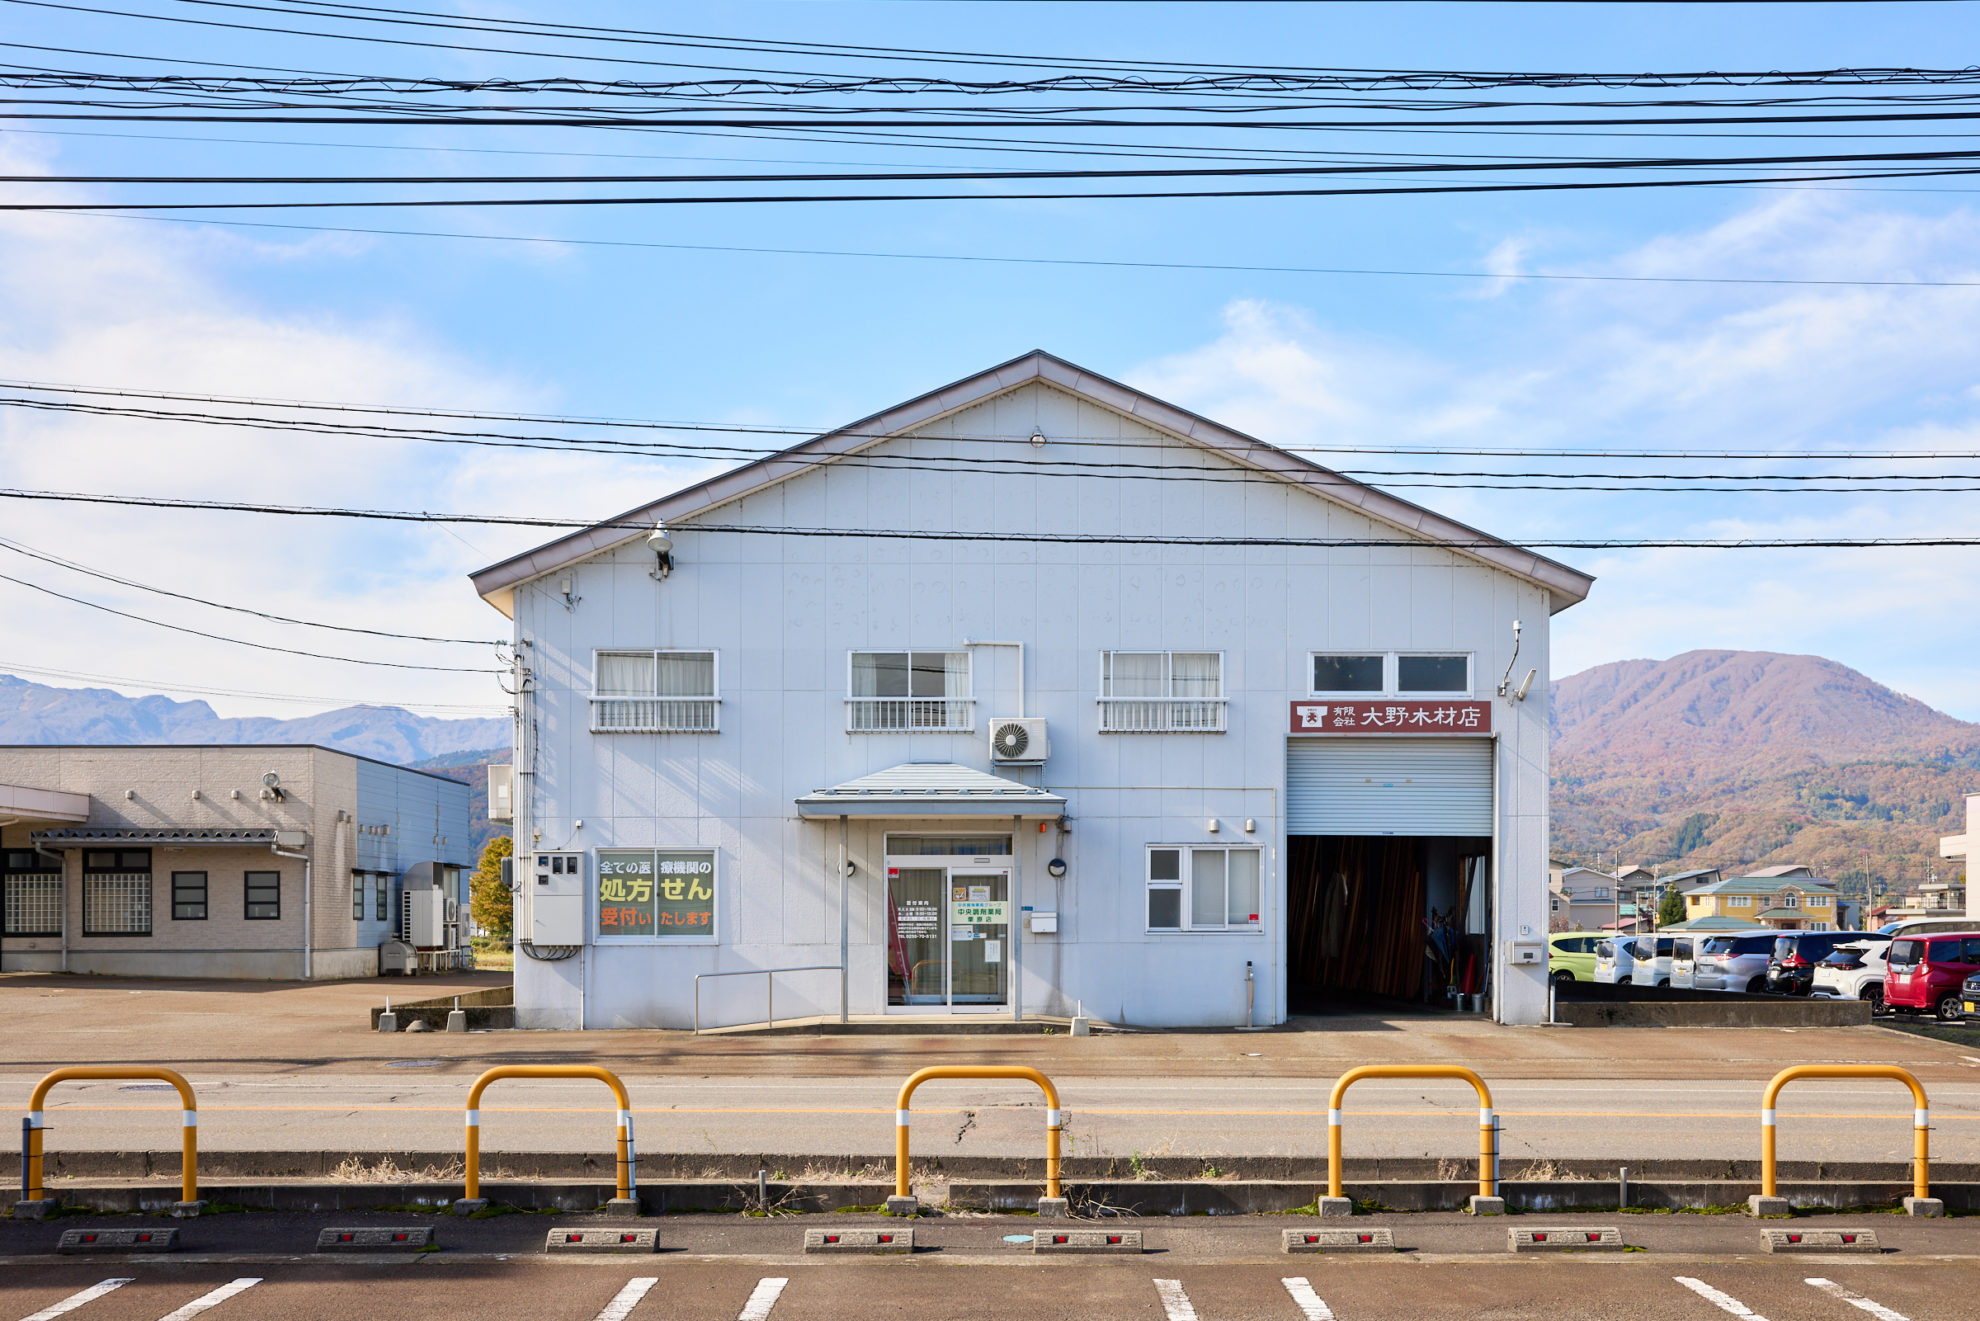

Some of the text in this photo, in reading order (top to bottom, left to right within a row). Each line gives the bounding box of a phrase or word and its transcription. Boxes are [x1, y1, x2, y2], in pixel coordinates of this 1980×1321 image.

[1332, 706, 1356, 717] 有限
[1360, 706, 1481, 727] 大野木材店
[1332, 717, 1356, 727] 会社
[600, 861, 712, 874] 全ての医療機関の
[600, 878, 712, 902] 処方せん
[600, 907, 712, 926] 受付いたします
